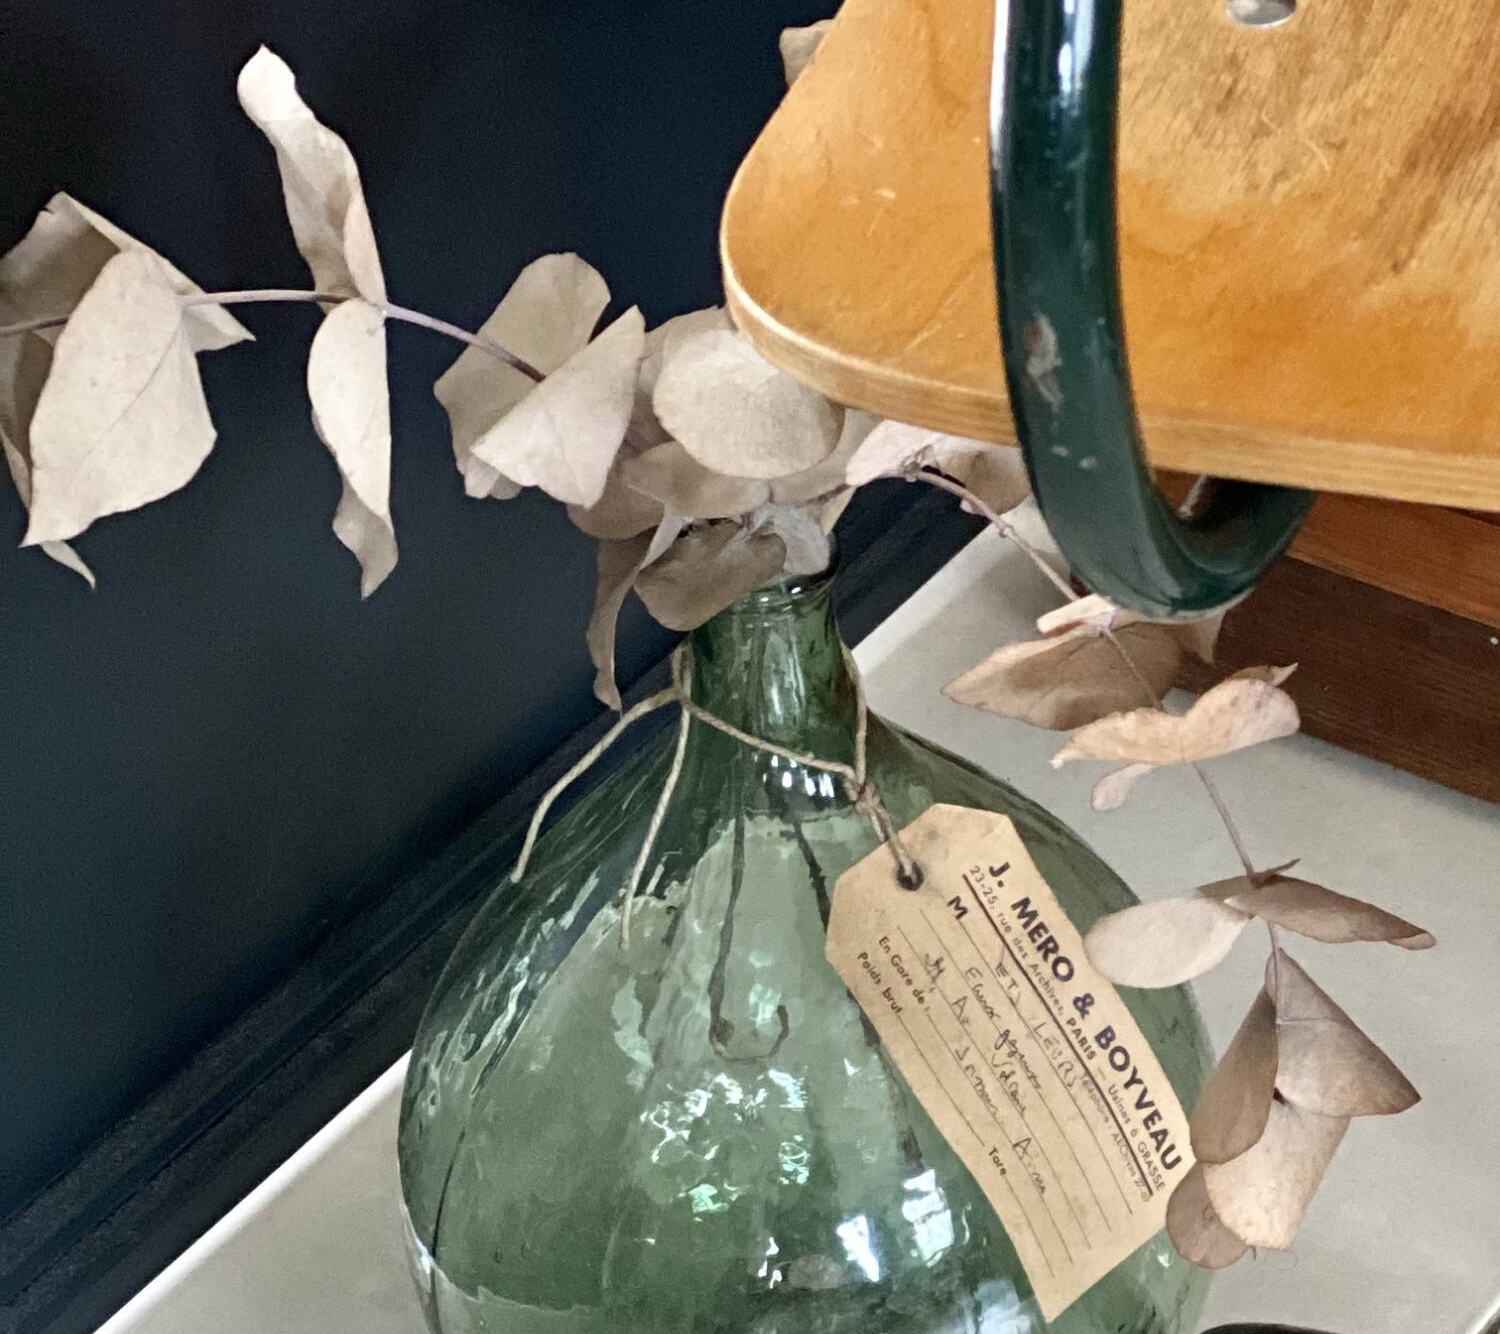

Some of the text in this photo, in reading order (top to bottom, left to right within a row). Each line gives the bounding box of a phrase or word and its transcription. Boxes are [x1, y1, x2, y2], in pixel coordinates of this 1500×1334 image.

[946, 895, 968, 920] M
[856, 951, 903, 1014] Poids brut
[878, 935, 890, 953] En
[890, 953, 913, 986] Gare
[911, 988, 924, 1004] de
[969, 864, 998, 909] 23-25,
[996, 912, 1012, 933] rue
[1012, 936, 1028, 959] des
[1027, 963, 1063, 1016] Archives,
[1065, 1017, 1096, 1060] PARIS
[1107, 1083, 1131, 1124] Usines
[1129, 1140, 1165, 1191] GRASSE
[988, 861, 1182, 1170] J. MERO & BOYVEAU
[988, 1145, 1007, 1176] Tare
